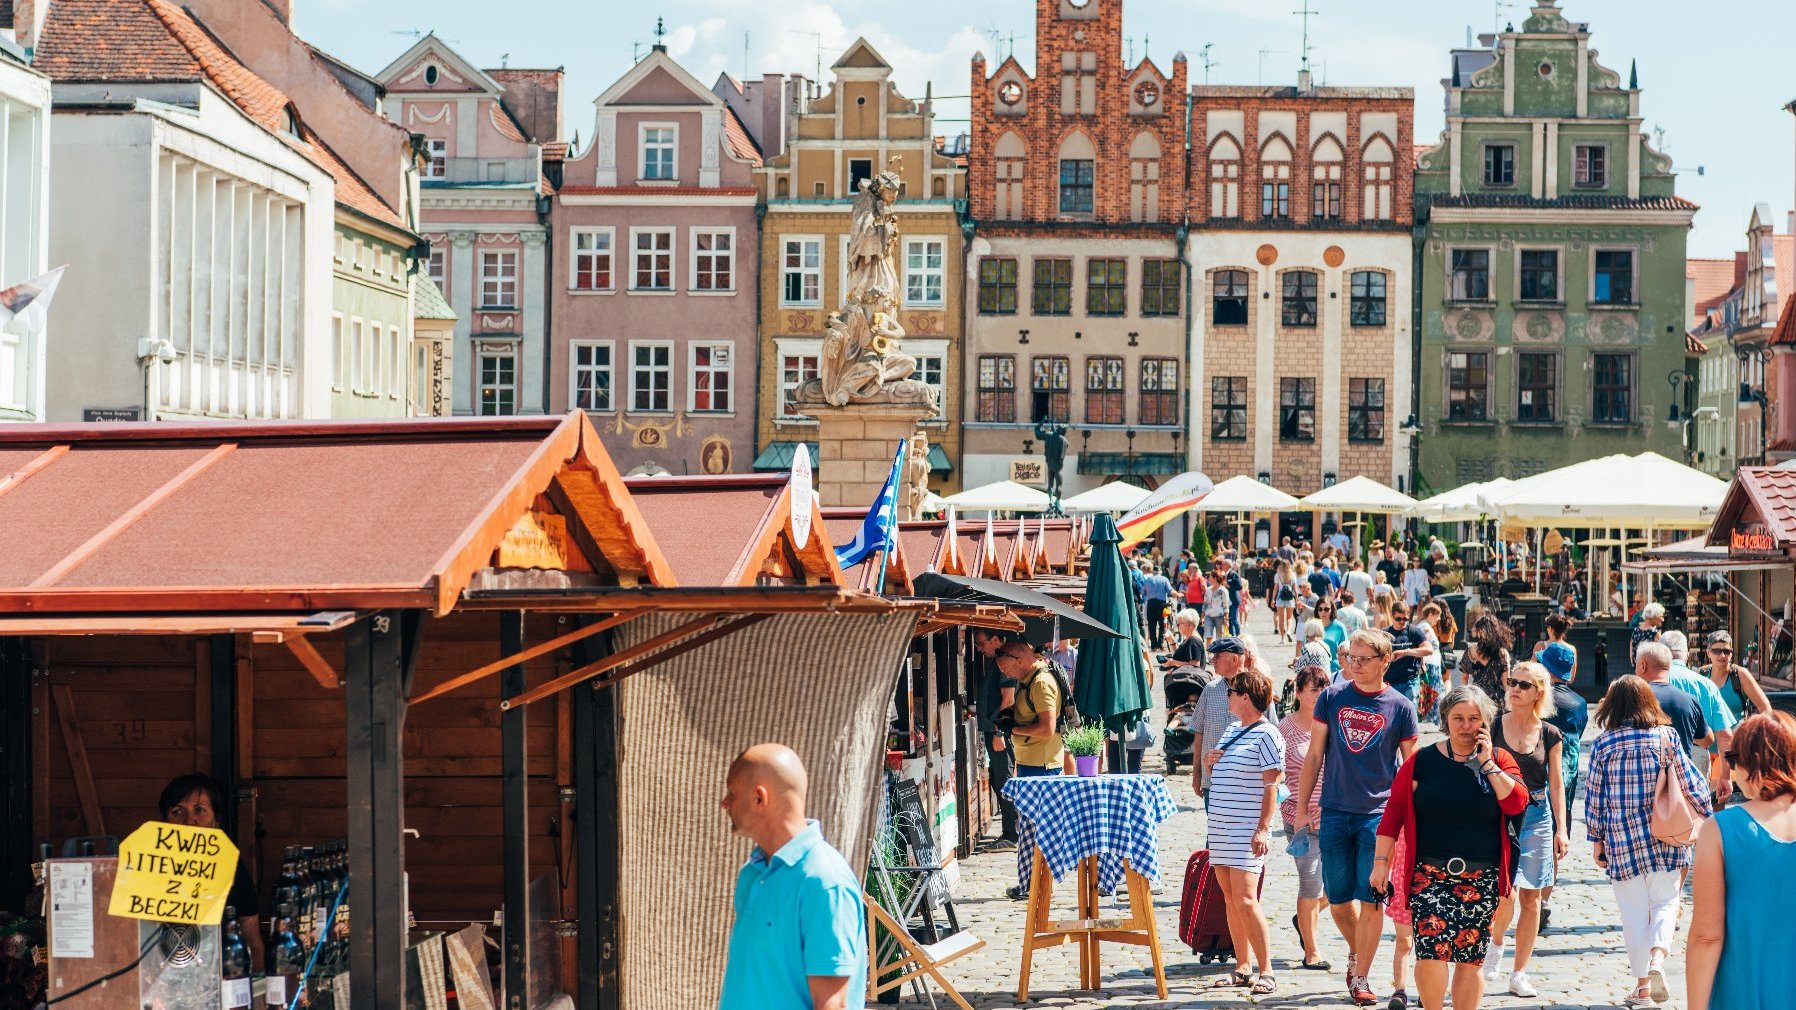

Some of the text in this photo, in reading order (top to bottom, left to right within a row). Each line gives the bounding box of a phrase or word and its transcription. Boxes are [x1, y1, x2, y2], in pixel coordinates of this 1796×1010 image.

[372, 615, 390, 633] 39
[1343, 711, 1381, 725] Motor Oil
[155, 827, 220, 856] KWAS
[125, 851, 217, 880] LITEWSKI
[165, 880, 182, 894] Z
[128, 895, 200, 921] BECZKI
